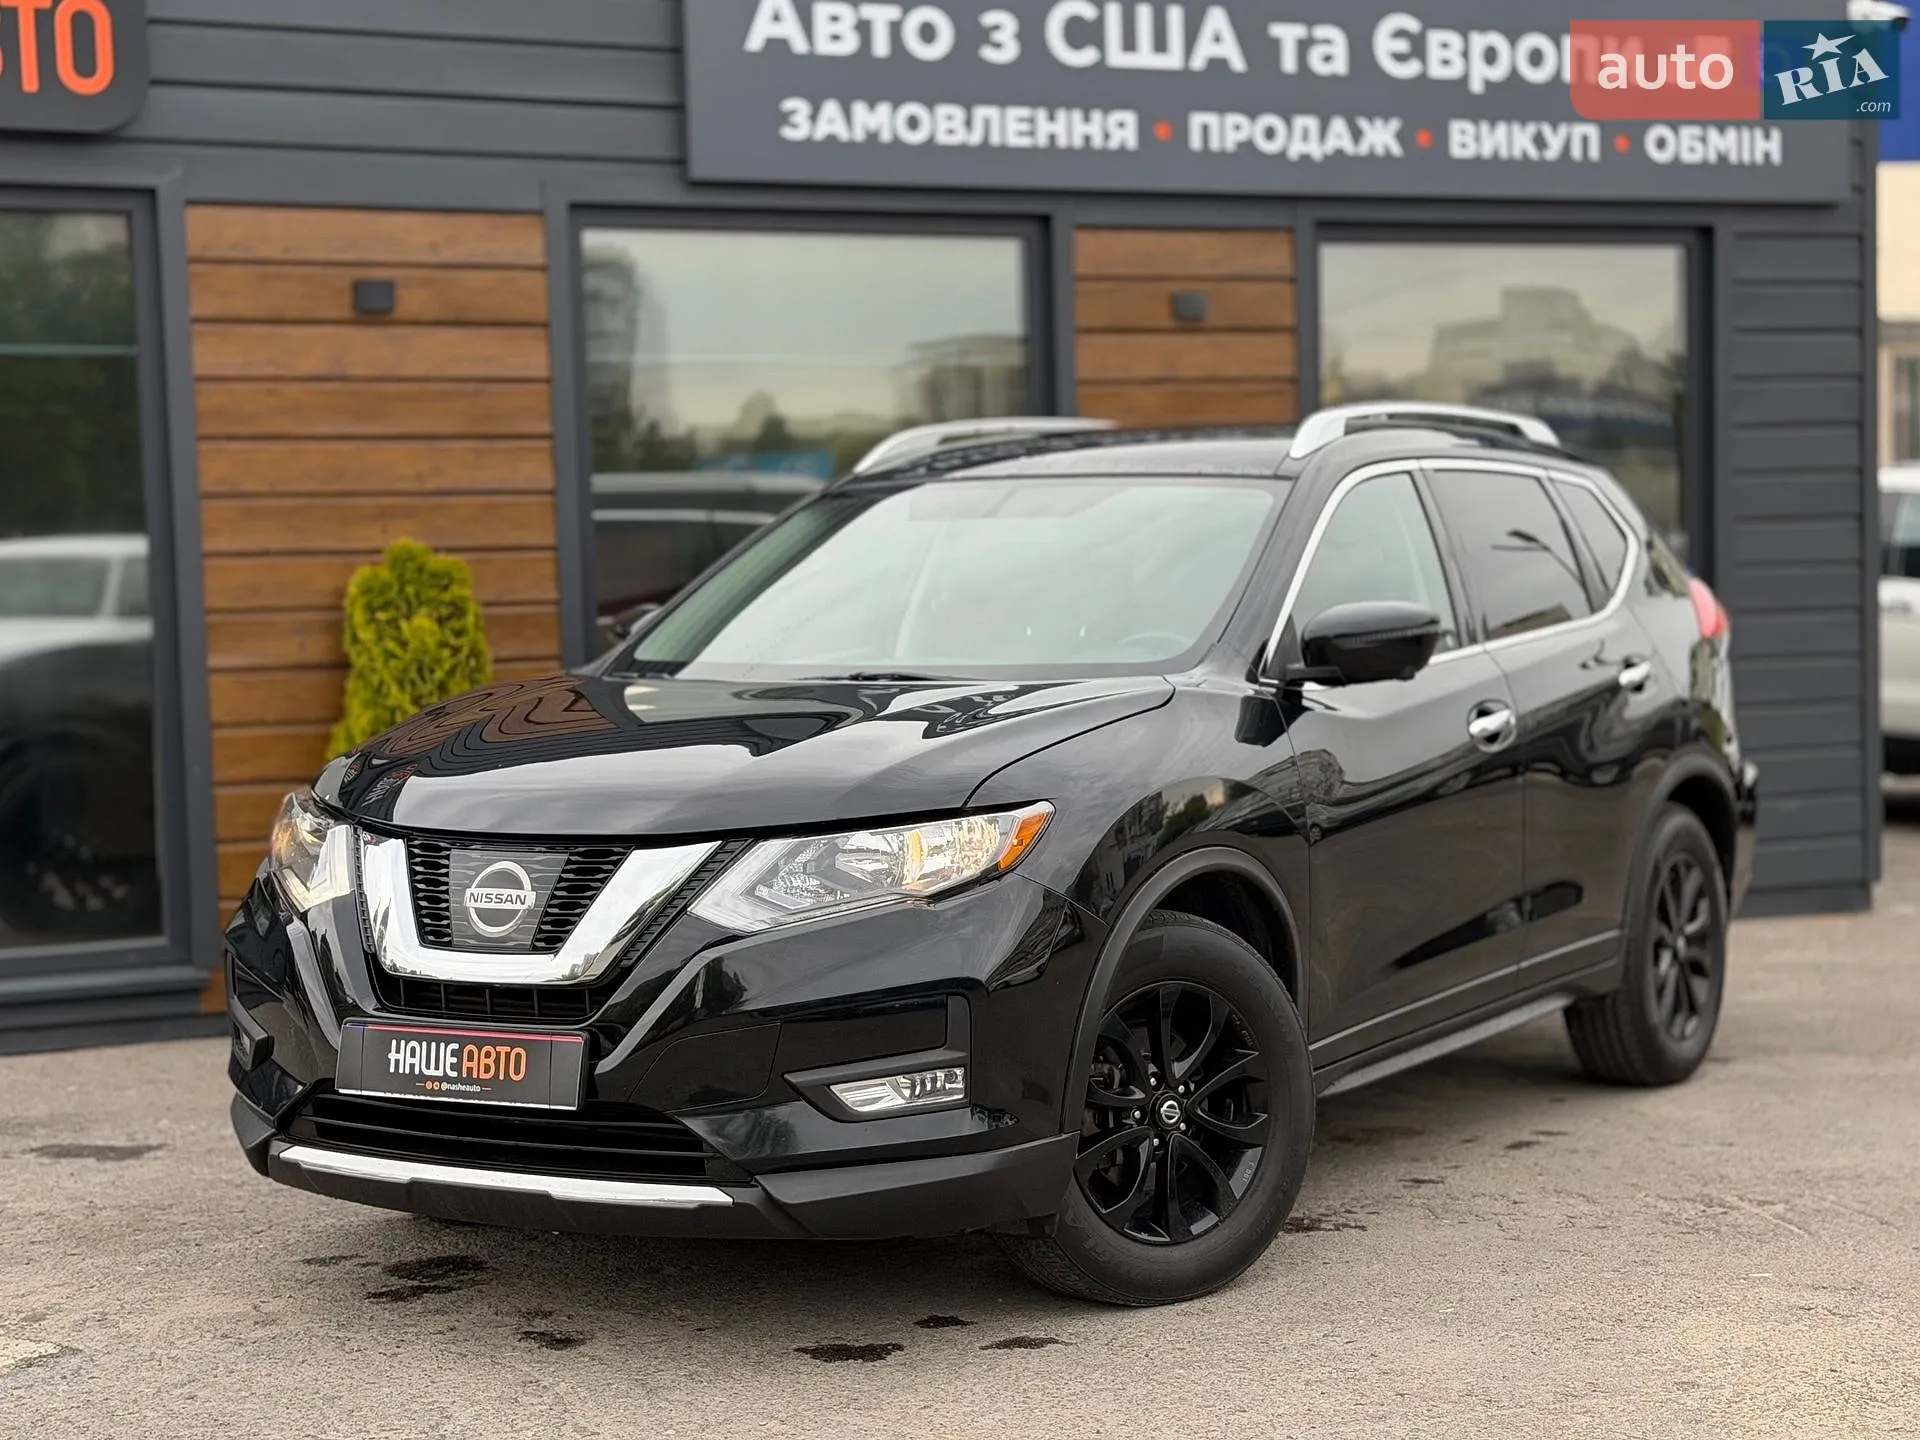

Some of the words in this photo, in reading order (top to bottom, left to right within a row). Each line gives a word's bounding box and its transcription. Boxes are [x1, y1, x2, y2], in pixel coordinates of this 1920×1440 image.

[744, 0, 955, 61] Авто
[978, 10, 1021, 64] з
[1045, 0, 1247, 72] США
[1268, 22, 1349, 75] та
[779, 97, 1138, 150] ЗАМОВЛЕННЯ
[1188, 111, 1403, 161] ПРОДАЖ
[1449, 120, 1600, 161] ВИКУП
[1644, 125, 1782, 164] ОБМІН
[468, 892, 527, 906] NISSAN
[388, 1039, 460, 1077] НАШЕ
[462, 1044, 527, 1081] АВТО
